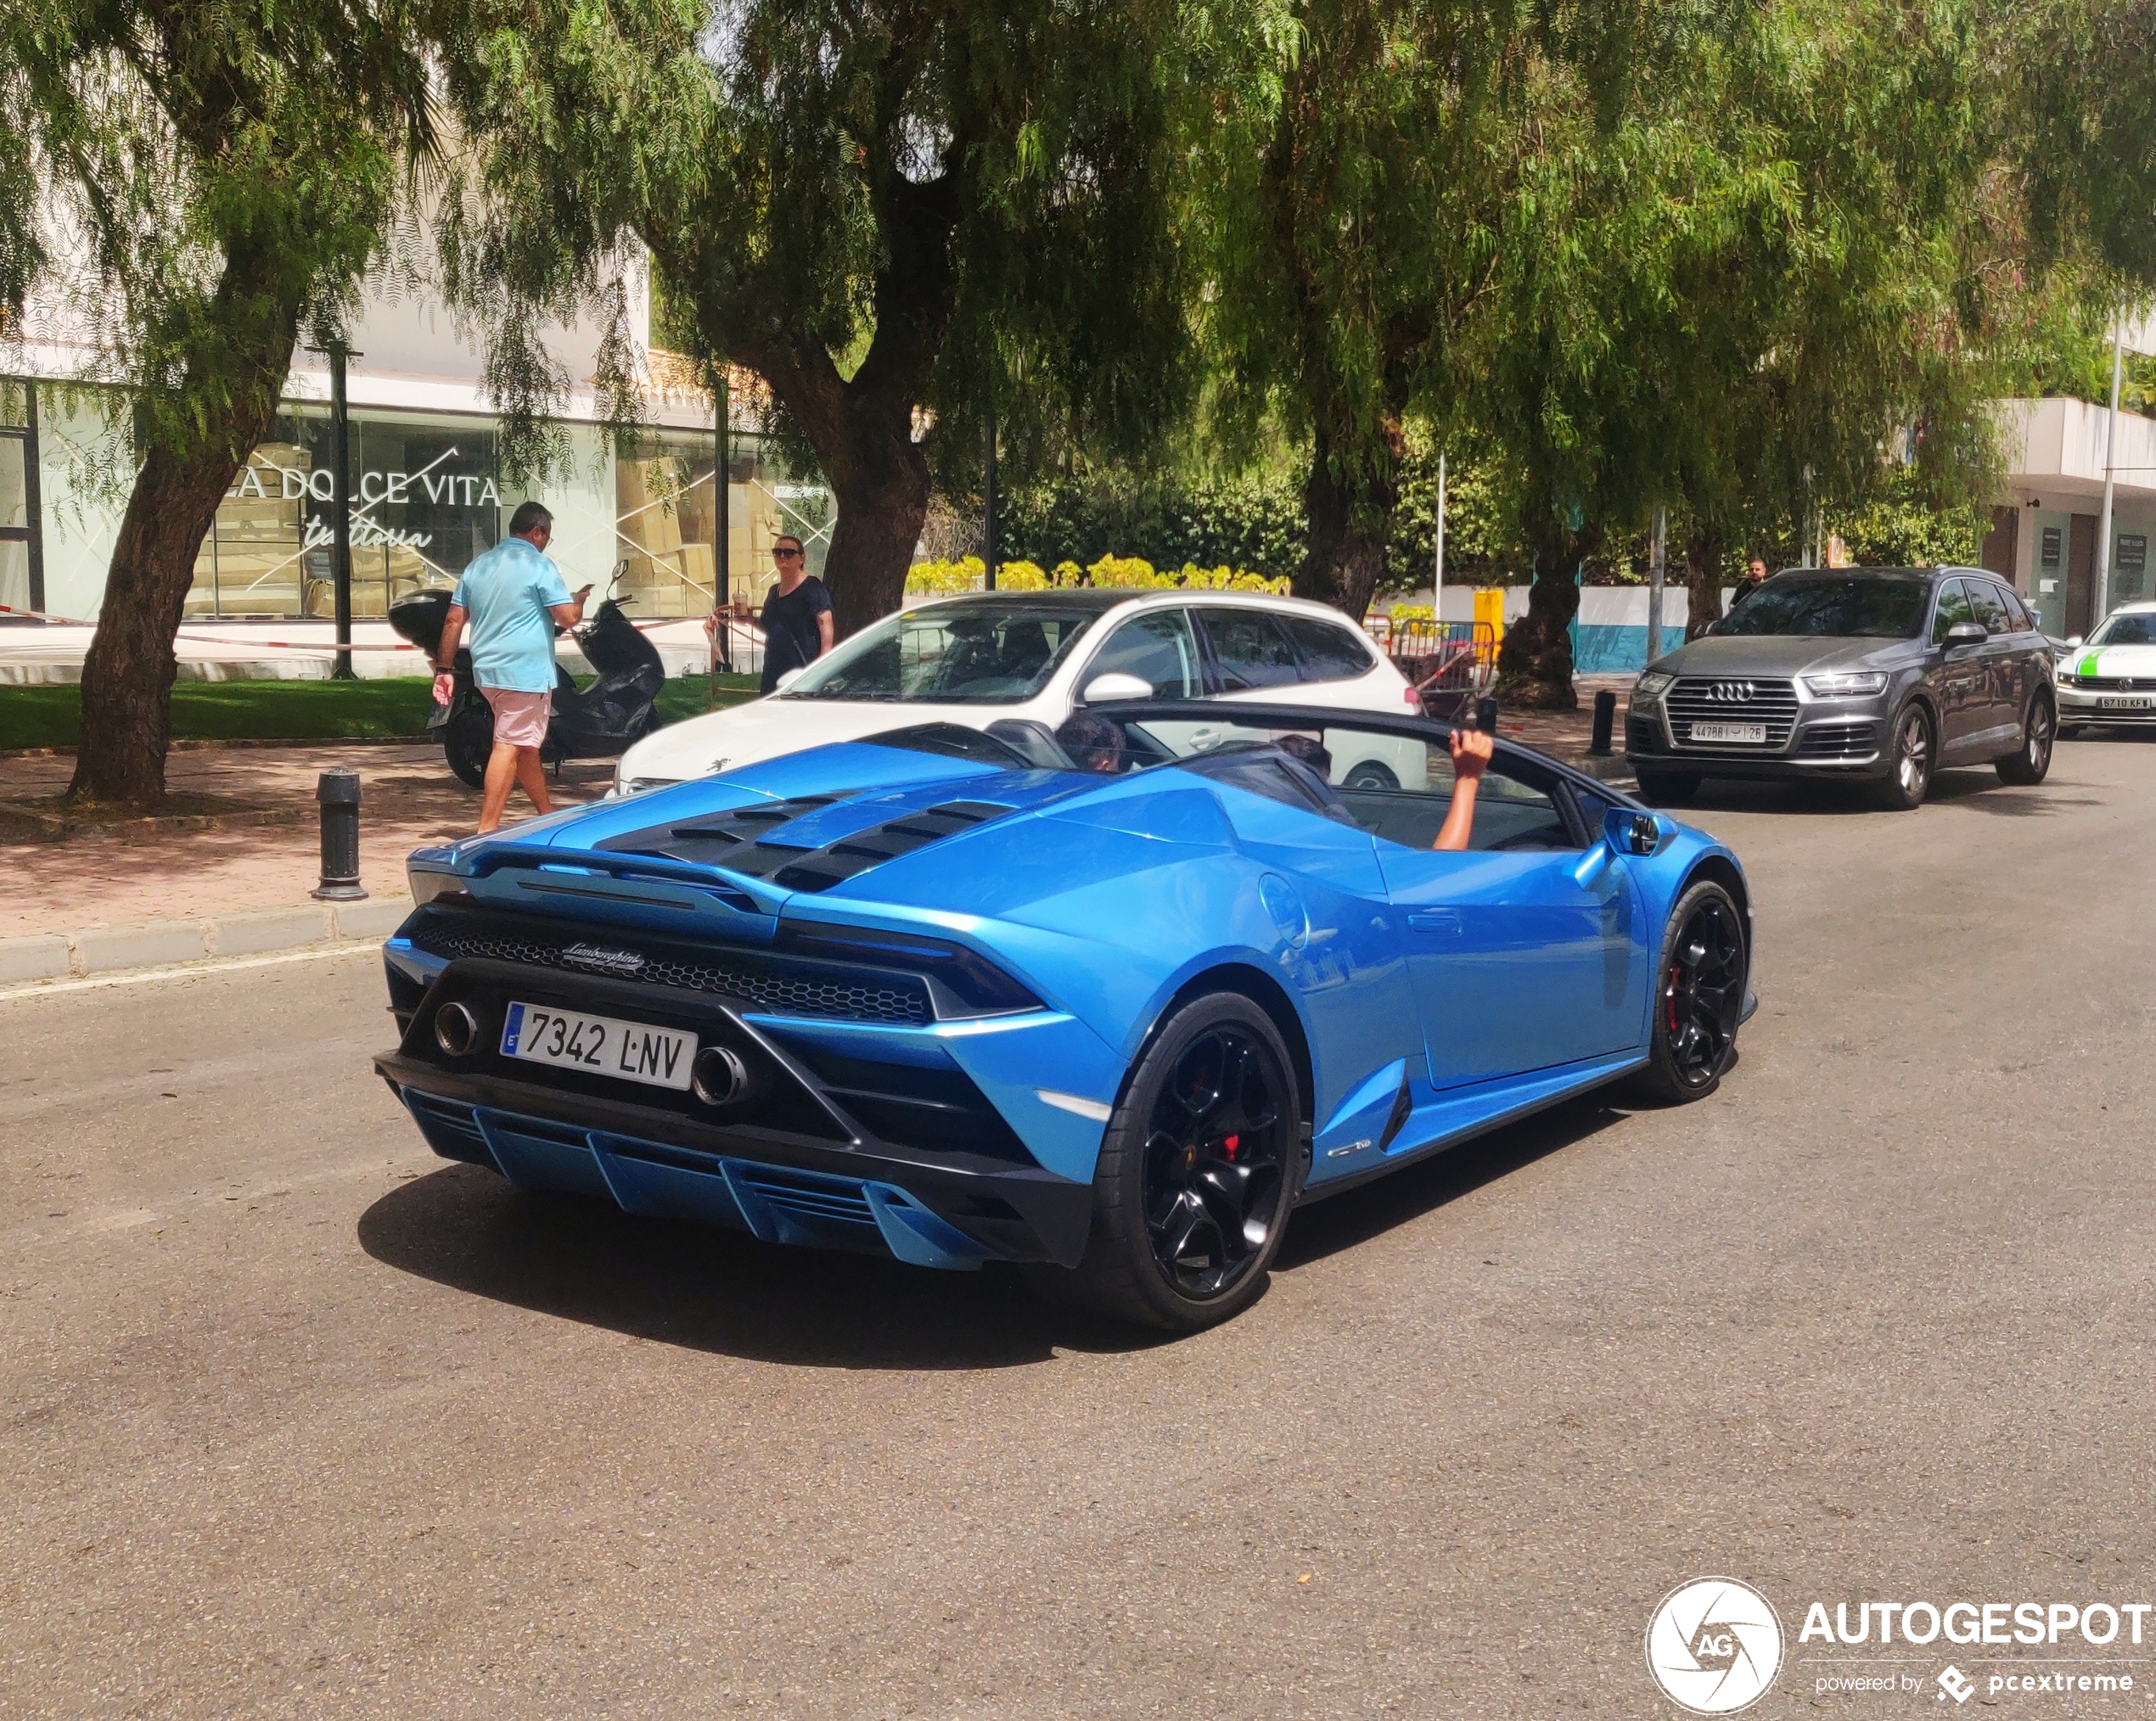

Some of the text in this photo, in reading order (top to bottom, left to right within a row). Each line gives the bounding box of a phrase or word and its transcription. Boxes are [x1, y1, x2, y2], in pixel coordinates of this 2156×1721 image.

[224, 466, 503, 507] A DOCE VITA
[304, 513, 433, 547] trttoria
[526, 1012, 606, 1065] 7342
